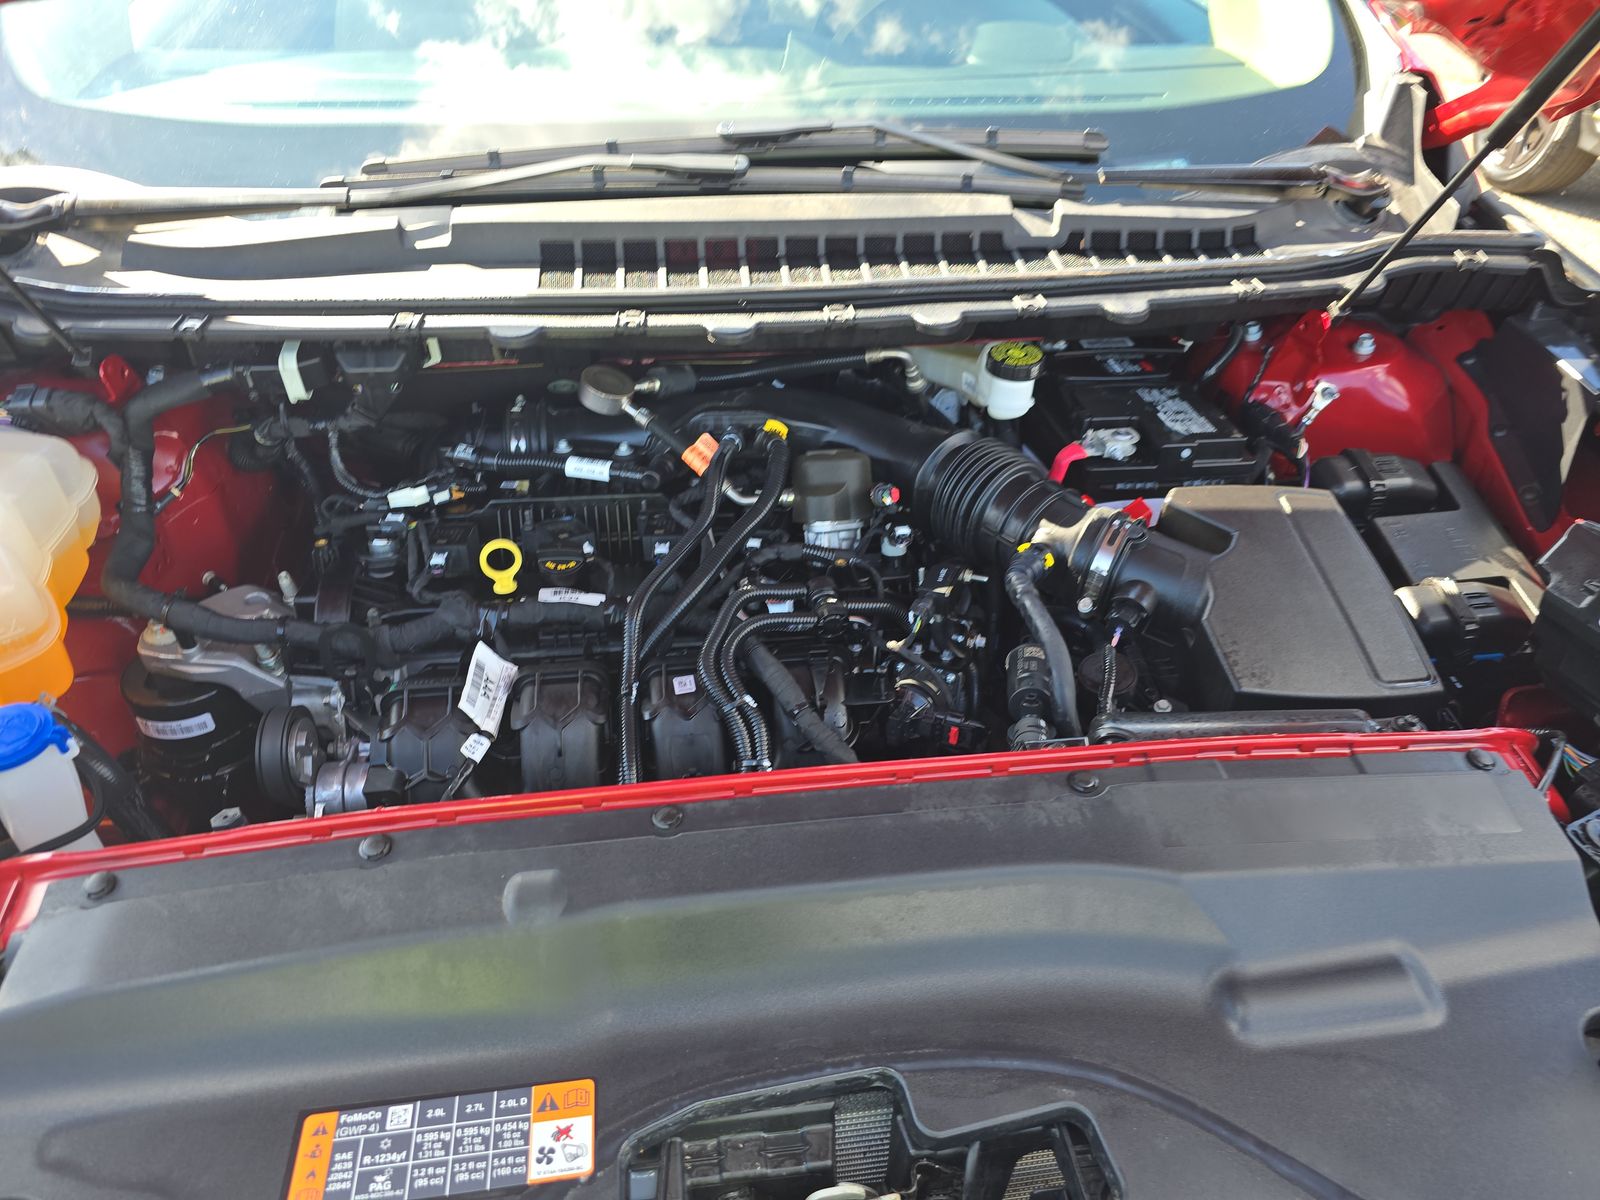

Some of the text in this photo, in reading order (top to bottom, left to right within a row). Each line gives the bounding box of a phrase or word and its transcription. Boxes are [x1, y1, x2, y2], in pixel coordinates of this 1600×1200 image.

[465, 1103, 485, 1113] 2.7L
[500, 1099, 518, 1108] 2.0L
[340, 1111, 382, 1124] FoMoCo
[426, 1108, 446, 1118] 2.0L
[518, 1121, 529, 1130] kg
[336, 1123, 380, 1138] (GWP 4)
[480, 1126, 490, 1135] kg
[440, 1131, 451, 1140] kg
[334, 1151, 353, 1161] SAE
[362, 1150, 407, 1165] R-1234yf
[331, 1161, 353, 1170] J639
[494, 1157, 506, 1166] 5.4
[454, 1162, 466, 1171] 3.2
[513, 1165, 526, 1174] cc)
[412, 1168, 425, 1177] 3.2
[470, 1171, 484, 1180] cc)
[429, 1176, 443, 1185] cc)
[368, 1181, 392, 1192] PAG
